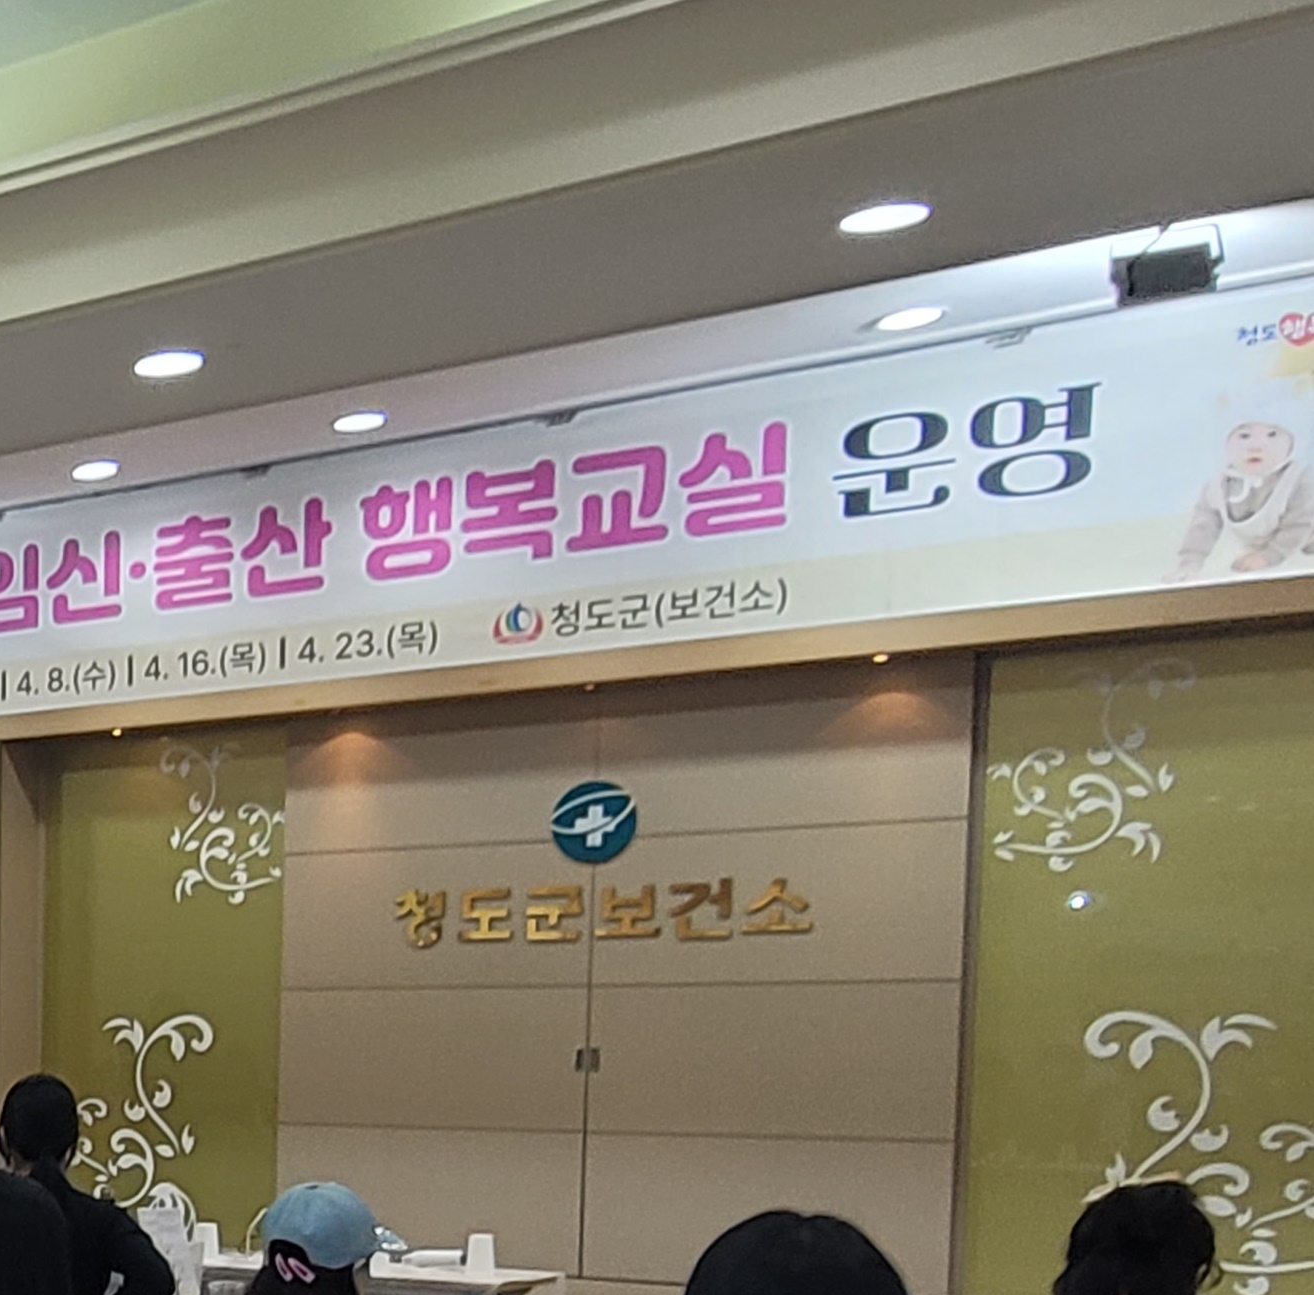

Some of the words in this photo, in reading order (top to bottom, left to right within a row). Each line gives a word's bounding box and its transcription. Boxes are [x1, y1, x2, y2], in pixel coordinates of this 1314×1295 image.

[359, 421, 788, 581] 행복교실
[832, 382, 1102, 519] 운영
[550, 576, 789, 638] 청도군(보건소)
[394, 877, 814, 950] 청도군보건소
